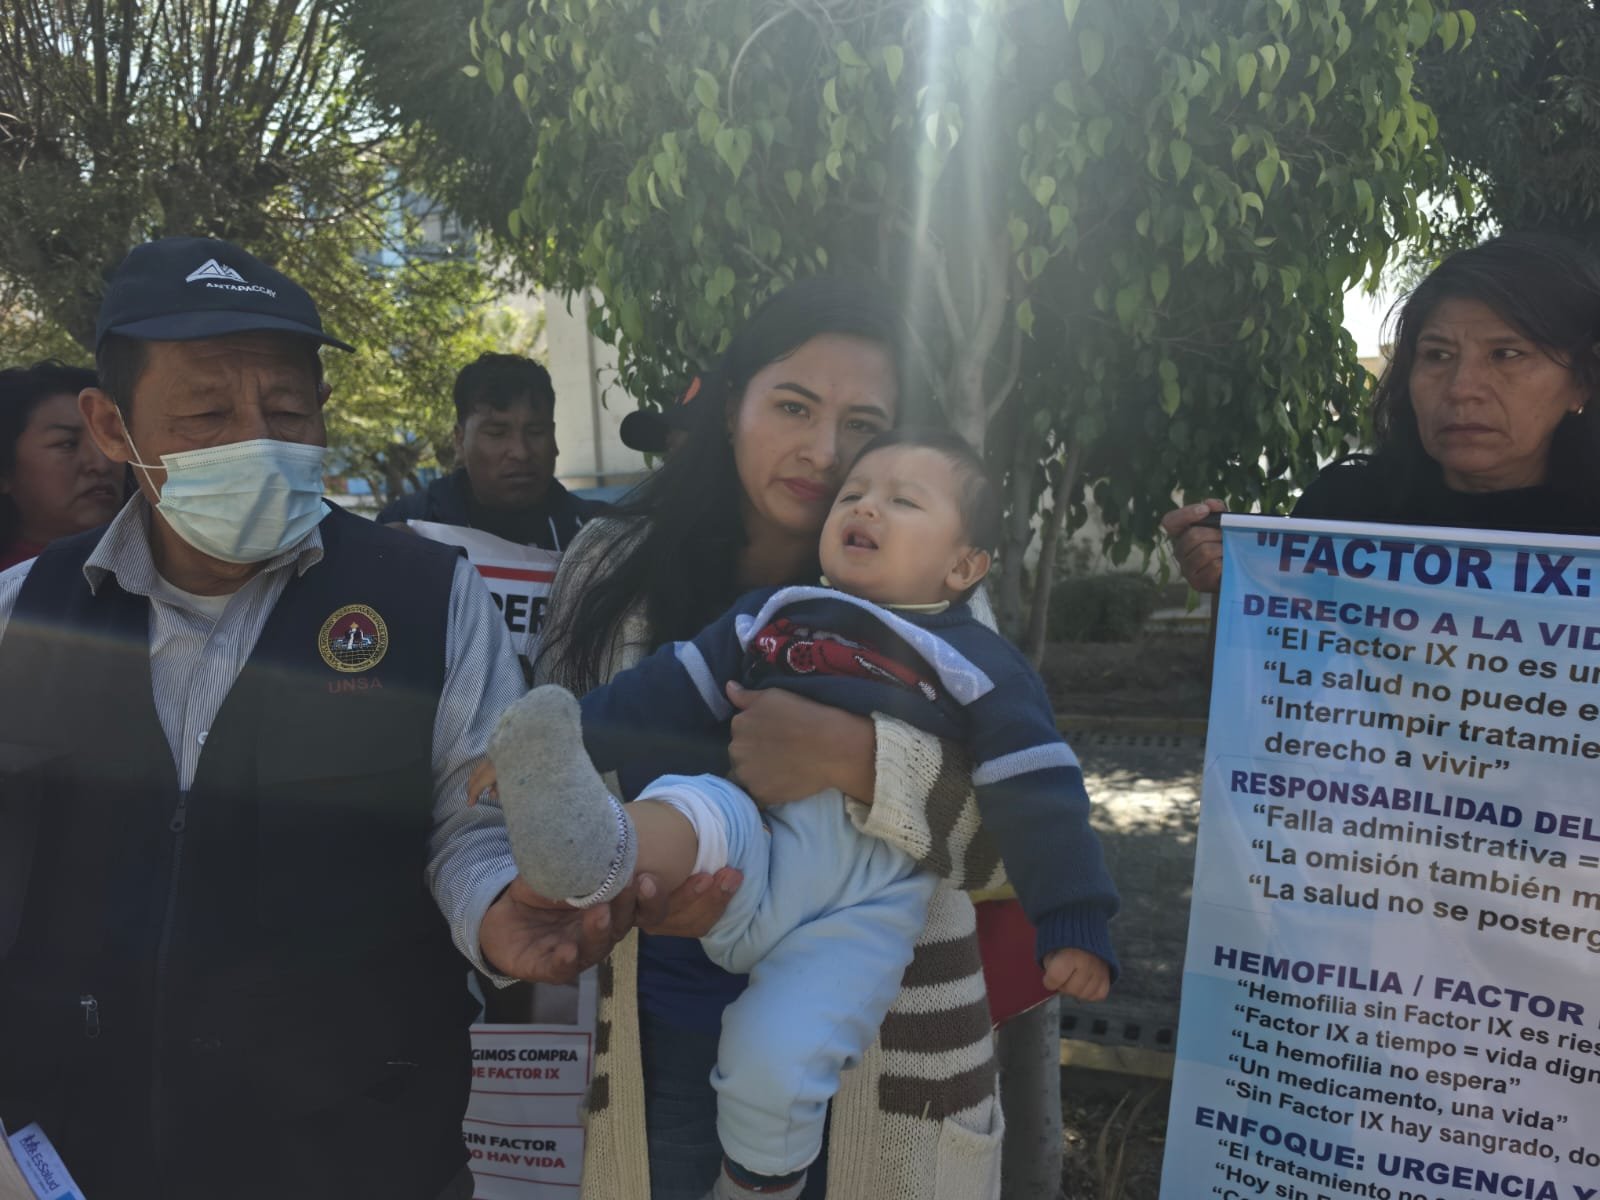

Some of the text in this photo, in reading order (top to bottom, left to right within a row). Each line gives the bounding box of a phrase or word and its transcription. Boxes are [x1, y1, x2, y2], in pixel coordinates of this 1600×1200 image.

[1256, 531, 1591, 597] "FACTOR IX:
[1243, 594, 1419, 631] DERECHO
[1431, 612, 1458, 636] A
[1472, 616, 1523, 643] LA
[1266, 626, 1307, 650] “El
[1318, 630, 1416, 662] Factor
[1425, 642, 1456, 667] IX
[1467, 653, 1508, 673] no
[1518, 659, 1557, 679] es
[328, 677, 383, 693] UNSA
[1263, 660, 1599, 721] “La salud no puede e
[1261, 695, 1600, 759] “Interrumpir tratamie
[1265, 732, 1510, 779] derecho a vivir”
[1230, 769, 1600, 842] RESPONSABILIDAD DEL
[1253, 803, 1333, 834] “Falla
[1342, 817, 1567, 869] administrativa
[1249, 874, 1295, 901] “La
[1303, 884, 1379, 911] salud
[1388, 894, 1424, 915] no
[1432, 900, 1468, 922] se
[1252, 839, 1296, 865] “La
[1306, 850, 1418, 879] omisión
[1429, 860, 1561, 904] también
[1213, 945, 1585, 1026] HEMOFILIA / FACTOR
[1237, 979, 1357, 1016] “Hemofilia
[1363, 1001, 1397, 1021] sin
[1404, 1004, 1481, 1032] Factor
[1487, 1016, 1513, 1038] IX
[1520, 1026, 1549, 1045] es
[519, 1049, 578, 1062] COMPRA
[1231, 1029, 1521, 1094] “La hemofilia no espera”
[1234, 1004, 1321, 1039] “Factor
[1326, 1023, 1349, 1043] IX
[1356, 1031, 1369, 1046] a
[1376, 1030, 1457, 1059] tiempo
[1463, 1045, 1479, 1057] =
[1486, 1047, 1537, 1071] vida
[488, 1068, 542, 1079] FACTOR
[545, 1068, 560, 1080] IX
[1228, 1054, 1568, 1131] “Un medicamento, una vida”
[490, 1136, 557, 1151] FACTOR
[1195, 1106, 1365, 1171] ENFOQUE:
[1377, 1153, 1558, 1200] URGENCIA
[1225, 1078, 1600, 1168] “Sin Factor IX hay sangrado, do
[31, 1152, 60, 1191] EsSalud
[487, 1152, 522, 1165] HAY
[523, 1156, 566, 1168] VIDA
[1215, 1162, 1270, 1194] “Hoy
[1218, 1138, 1249, 1161] “El
[1255, 1149, 1391, 1200] tratamiento
